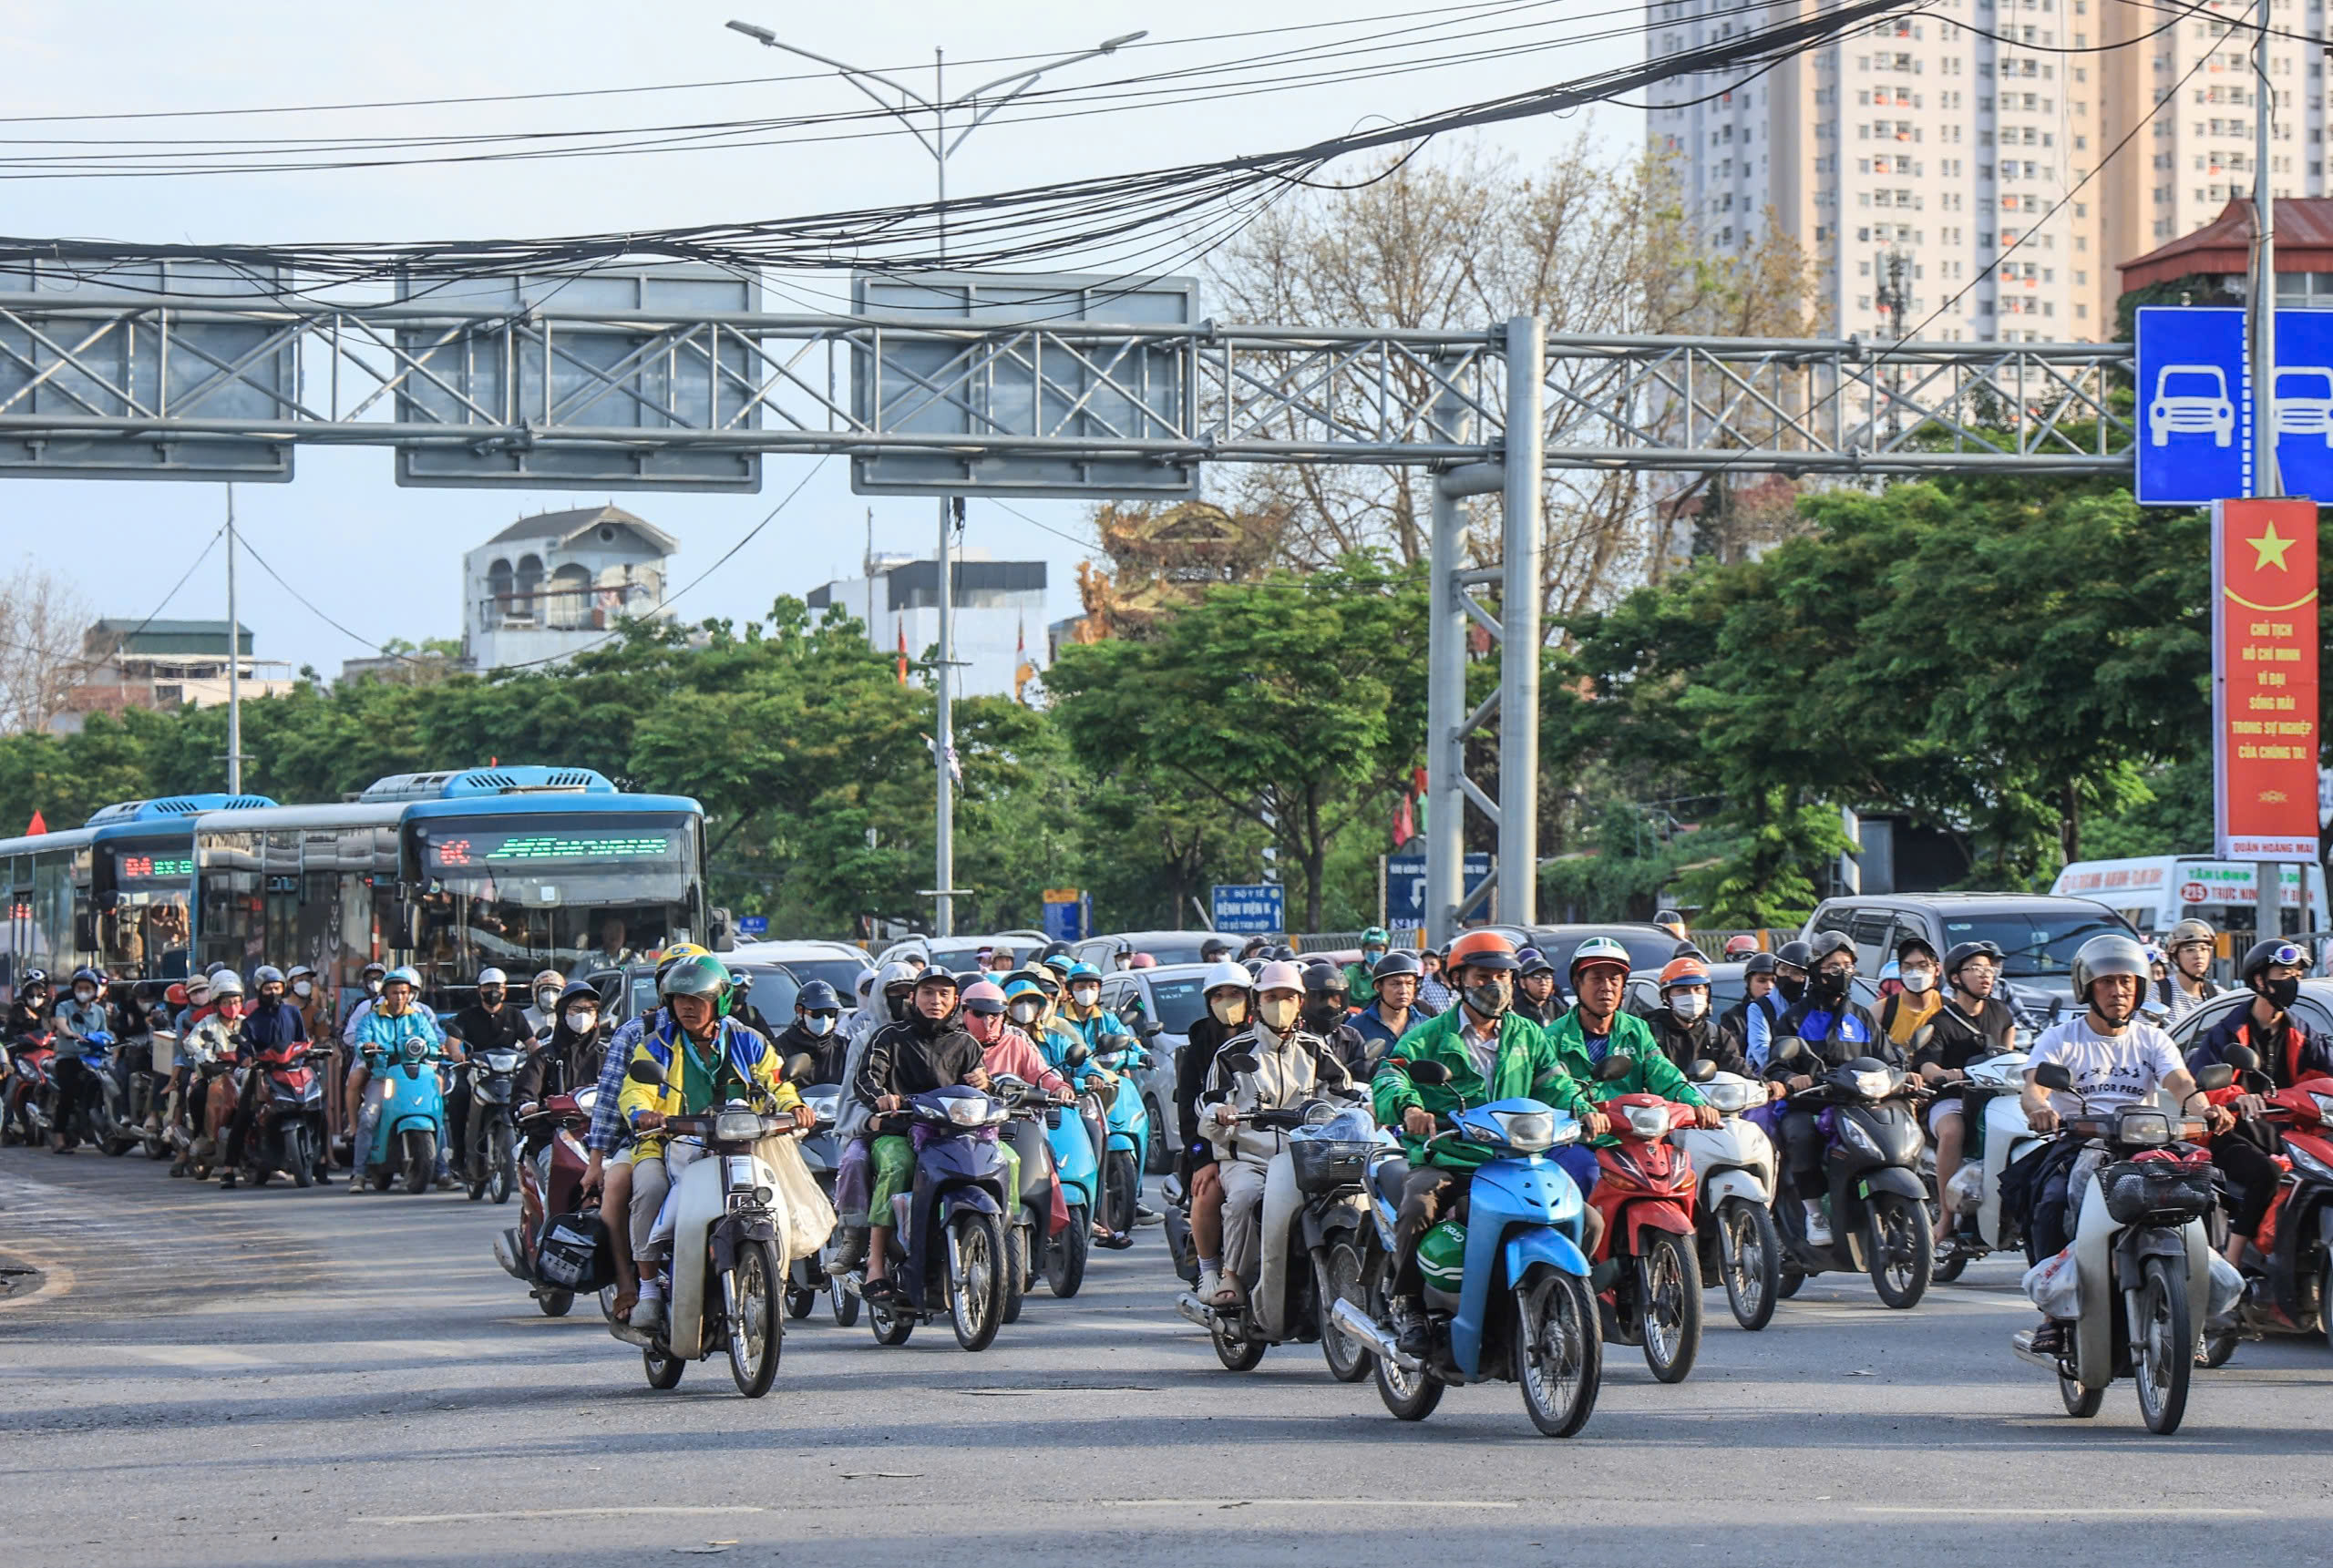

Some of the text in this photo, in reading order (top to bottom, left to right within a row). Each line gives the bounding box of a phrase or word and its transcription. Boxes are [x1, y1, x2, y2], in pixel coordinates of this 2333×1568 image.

[2296, 843, 2314, 853] MAI
[2098, 1083, 2116, 1092] FOR
[1442, 1225, 1465, 1243] Grab
